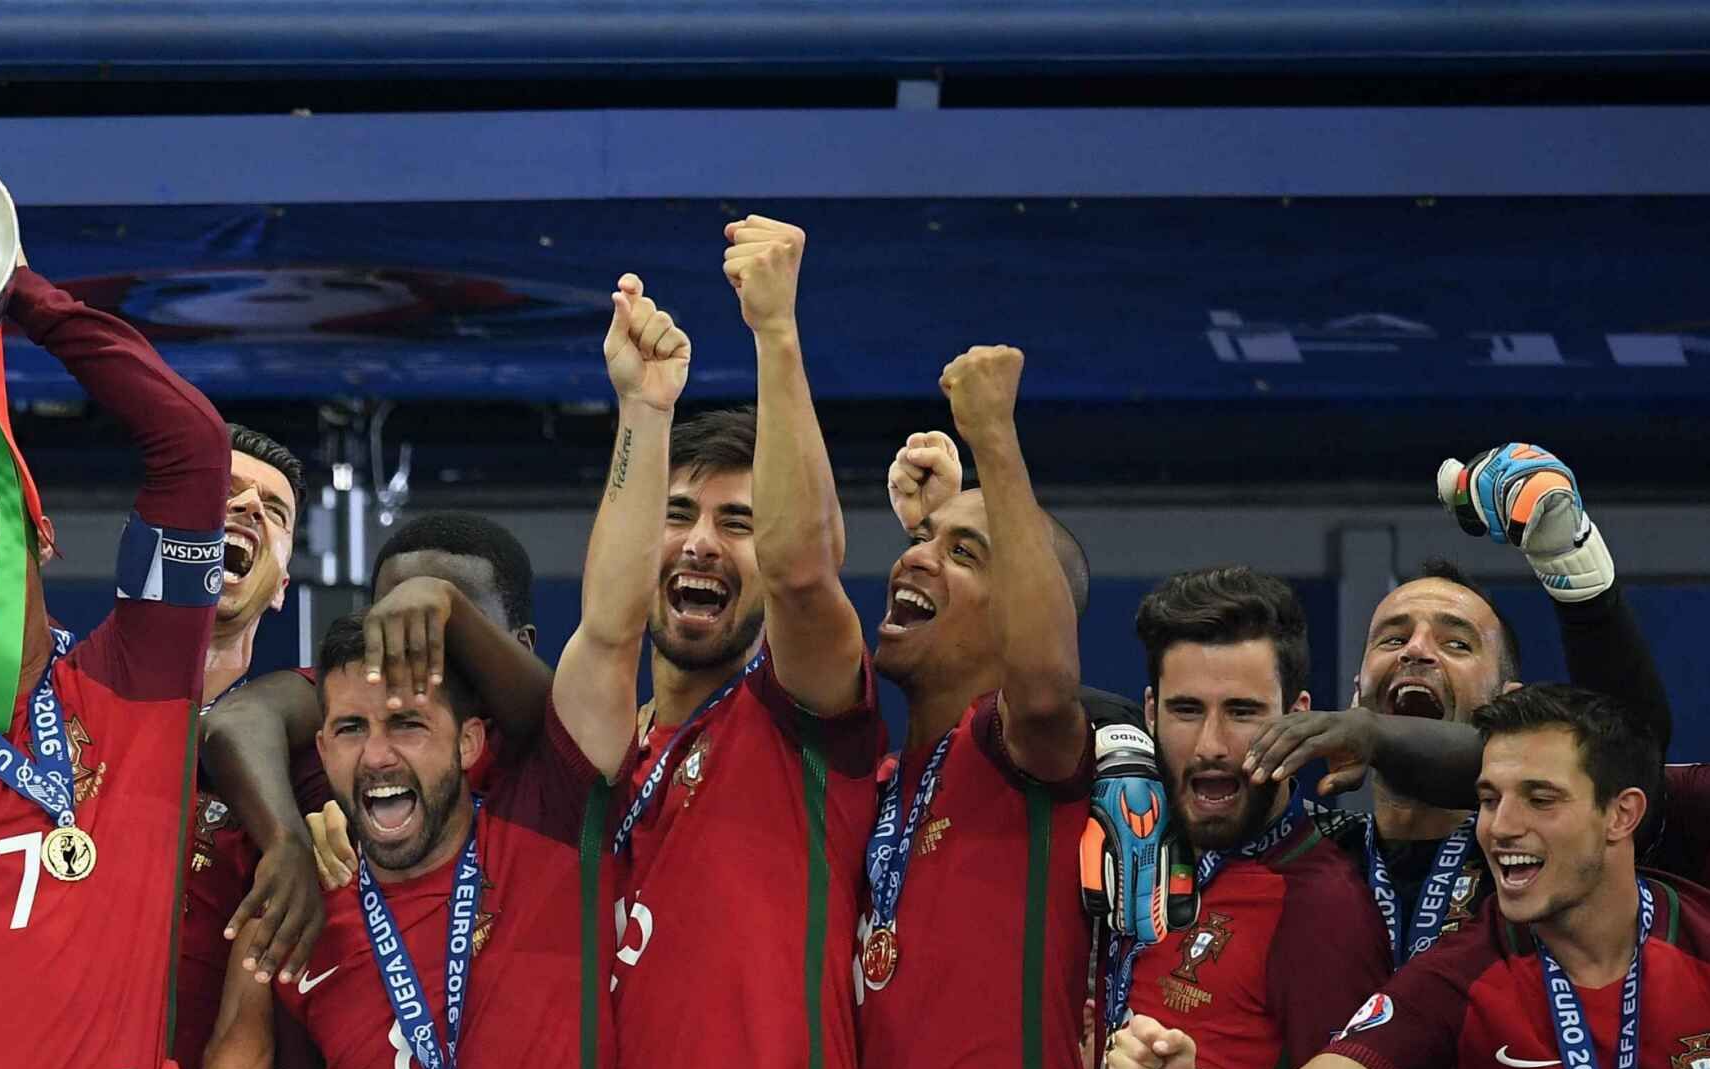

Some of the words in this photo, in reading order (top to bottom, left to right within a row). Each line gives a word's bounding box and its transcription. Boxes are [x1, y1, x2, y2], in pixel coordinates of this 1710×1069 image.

[161, 541, 221, 560] RACISM
[1110, 733, 1148, 745] ARDO
[363, 891, 399, 956] EURO
[450, 884, 475, 955] EURO
[1415, 871, 1455, 928] UEFA
[385, 954, 423, 1021] UEFA
[447, 959, 464, 1024] 2016
[1550, 977, 1585, 1045] EURO
